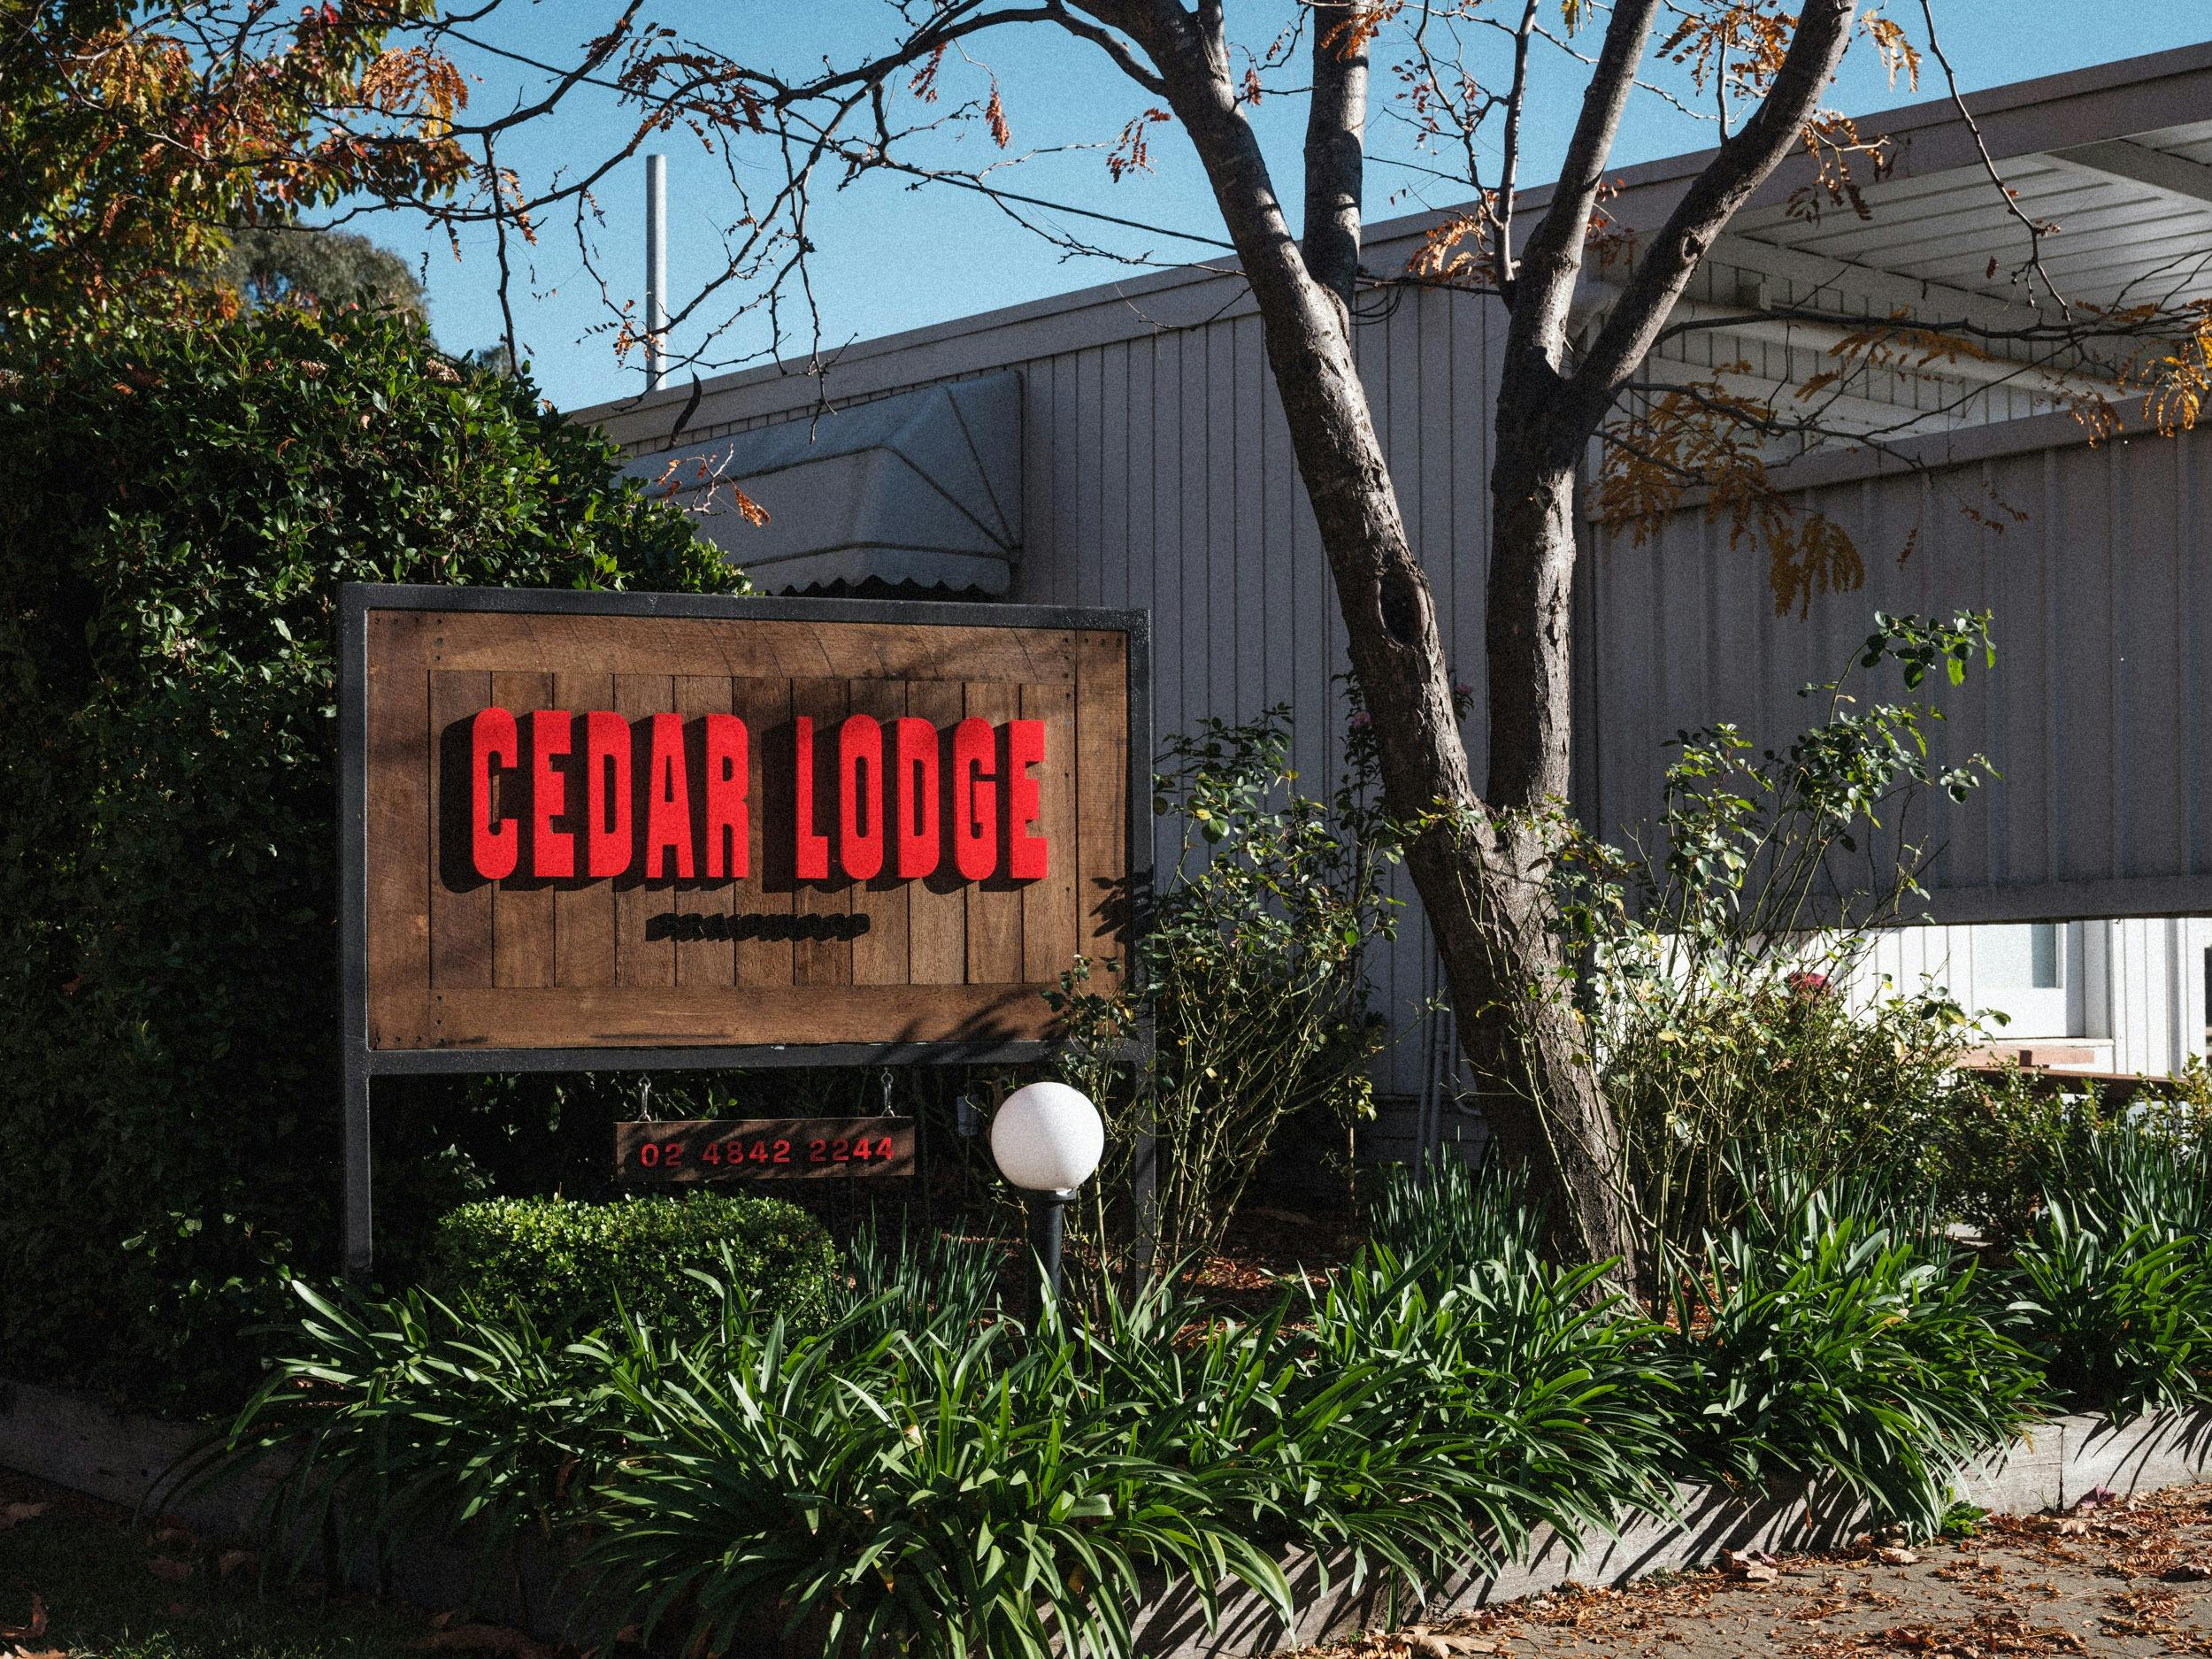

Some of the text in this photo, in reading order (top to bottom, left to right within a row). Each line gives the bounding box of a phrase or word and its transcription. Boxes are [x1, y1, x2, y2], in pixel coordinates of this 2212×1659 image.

[472, 707, 1049, 882] CEDAR LODGE
[641, 1137, 897, 1168] 02 4842 2244
